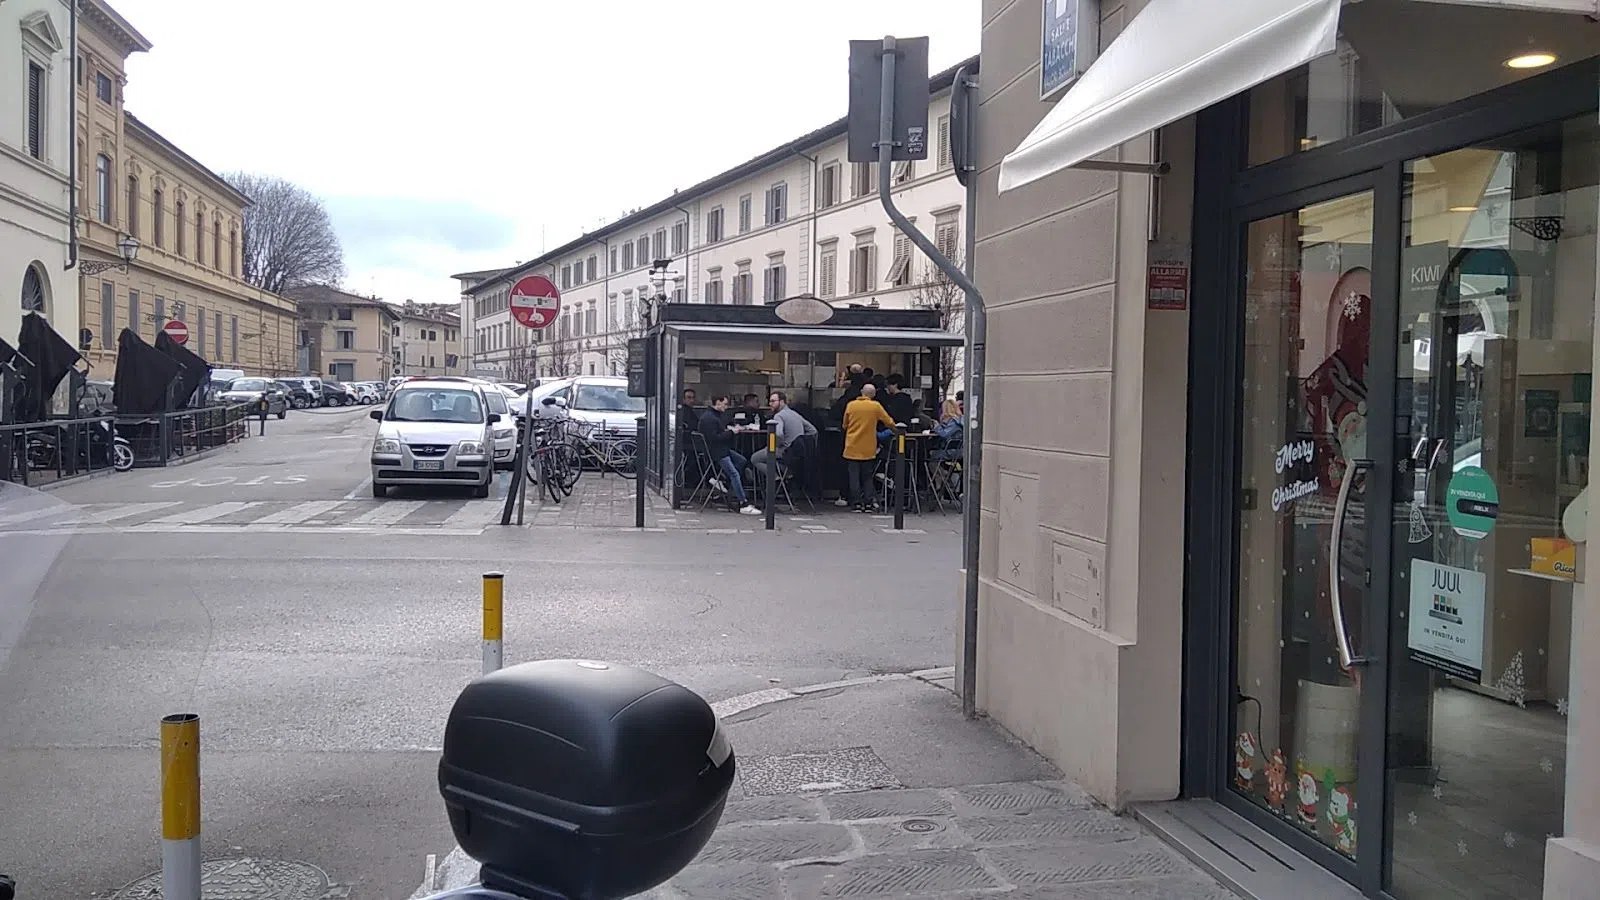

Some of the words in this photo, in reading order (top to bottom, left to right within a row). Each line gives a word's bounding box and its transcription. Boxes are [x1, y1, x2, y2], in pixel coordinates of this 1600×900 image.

[1150, 268, 1186, 276] ALLARME
[1411, 264, 1440, 284] KIWI
[1275, 440, 1315, 473] Merry
[1271, 476, 1319, 512] Christmas
[1432, 567, 1462, 593] JUUL
[1432, 630, 1453, 641] VENDITA
[1455, 636, 1466, 645] QUI
